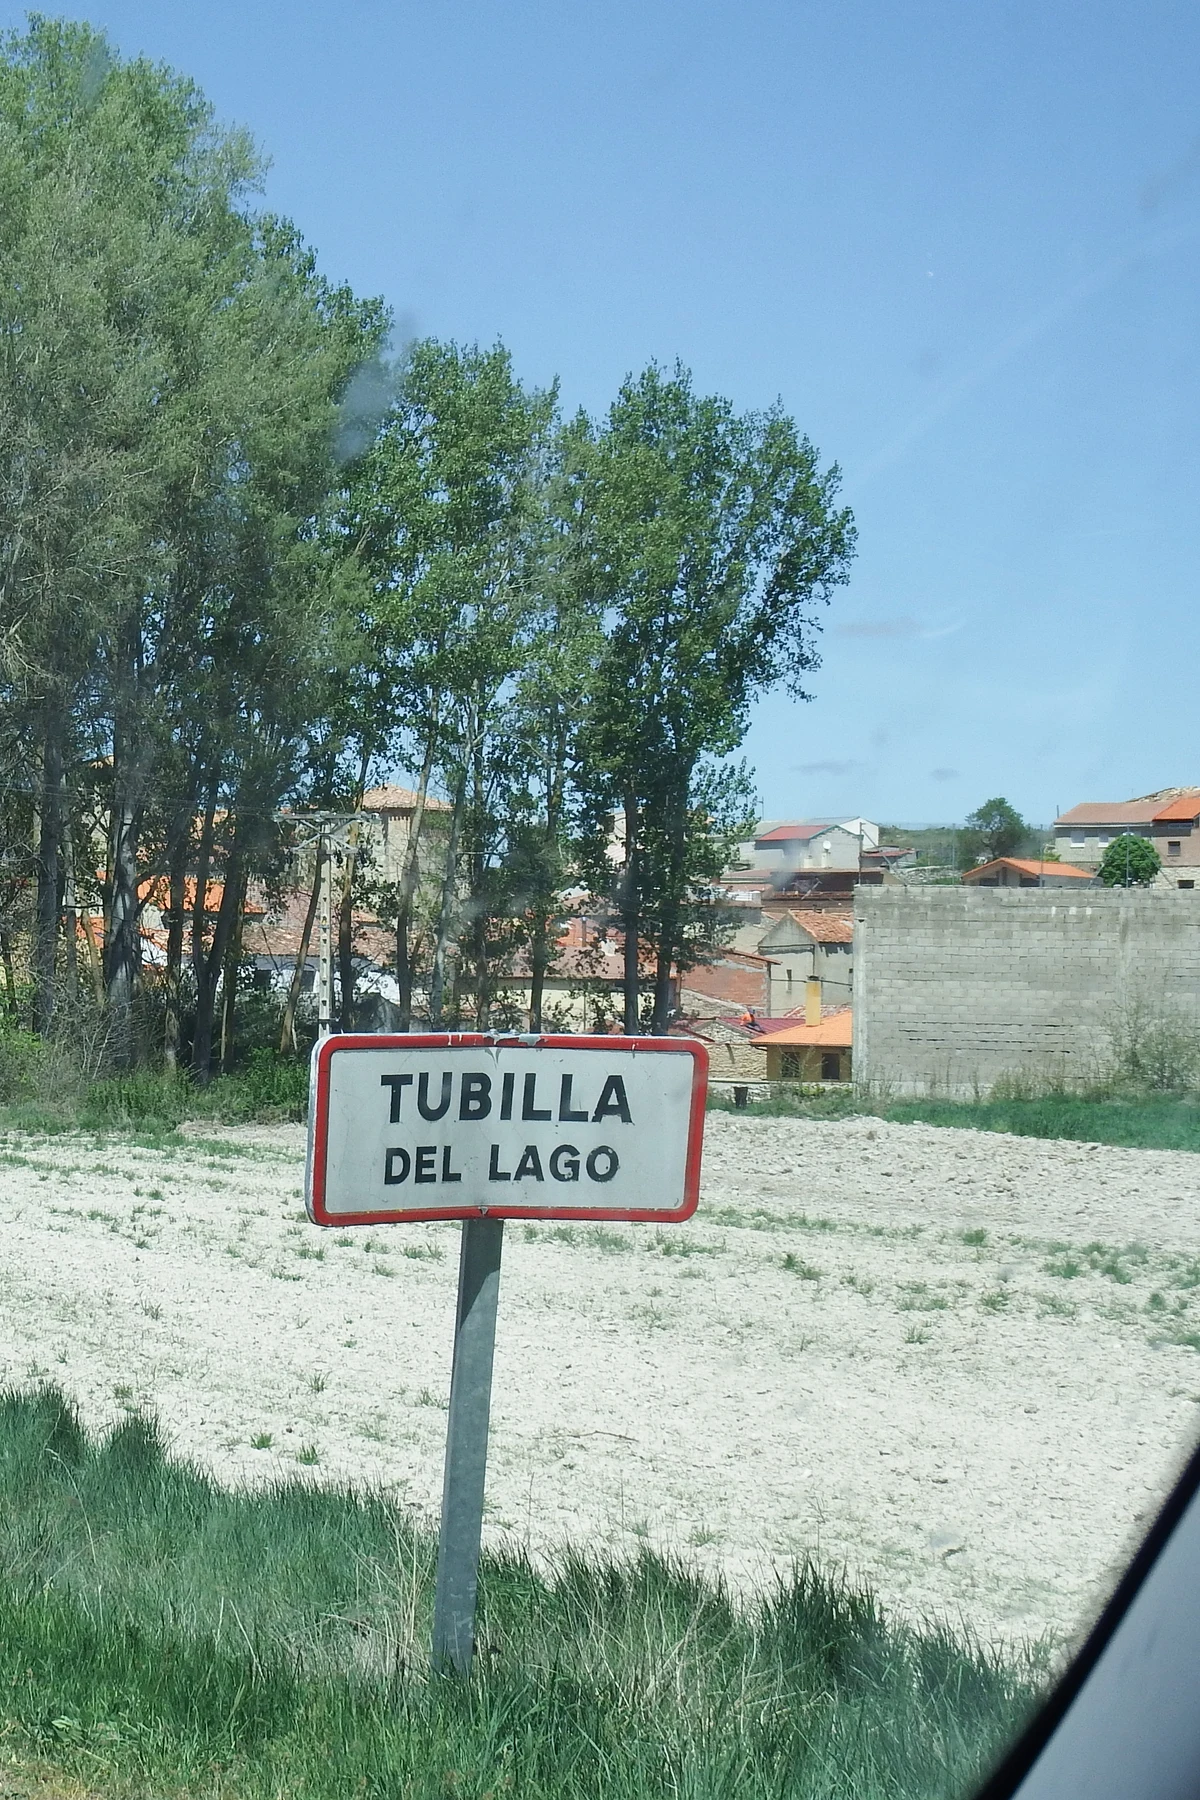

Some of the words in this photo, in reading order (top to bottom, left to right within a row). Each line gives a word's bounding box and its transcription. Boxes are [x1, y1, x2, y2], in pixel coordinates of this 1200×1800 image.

[380, 1071, 633, 1124] TUBILLA
[383, 1145, 462, 1186] DEL
[488, 1144, 620, 1183] LAGO
